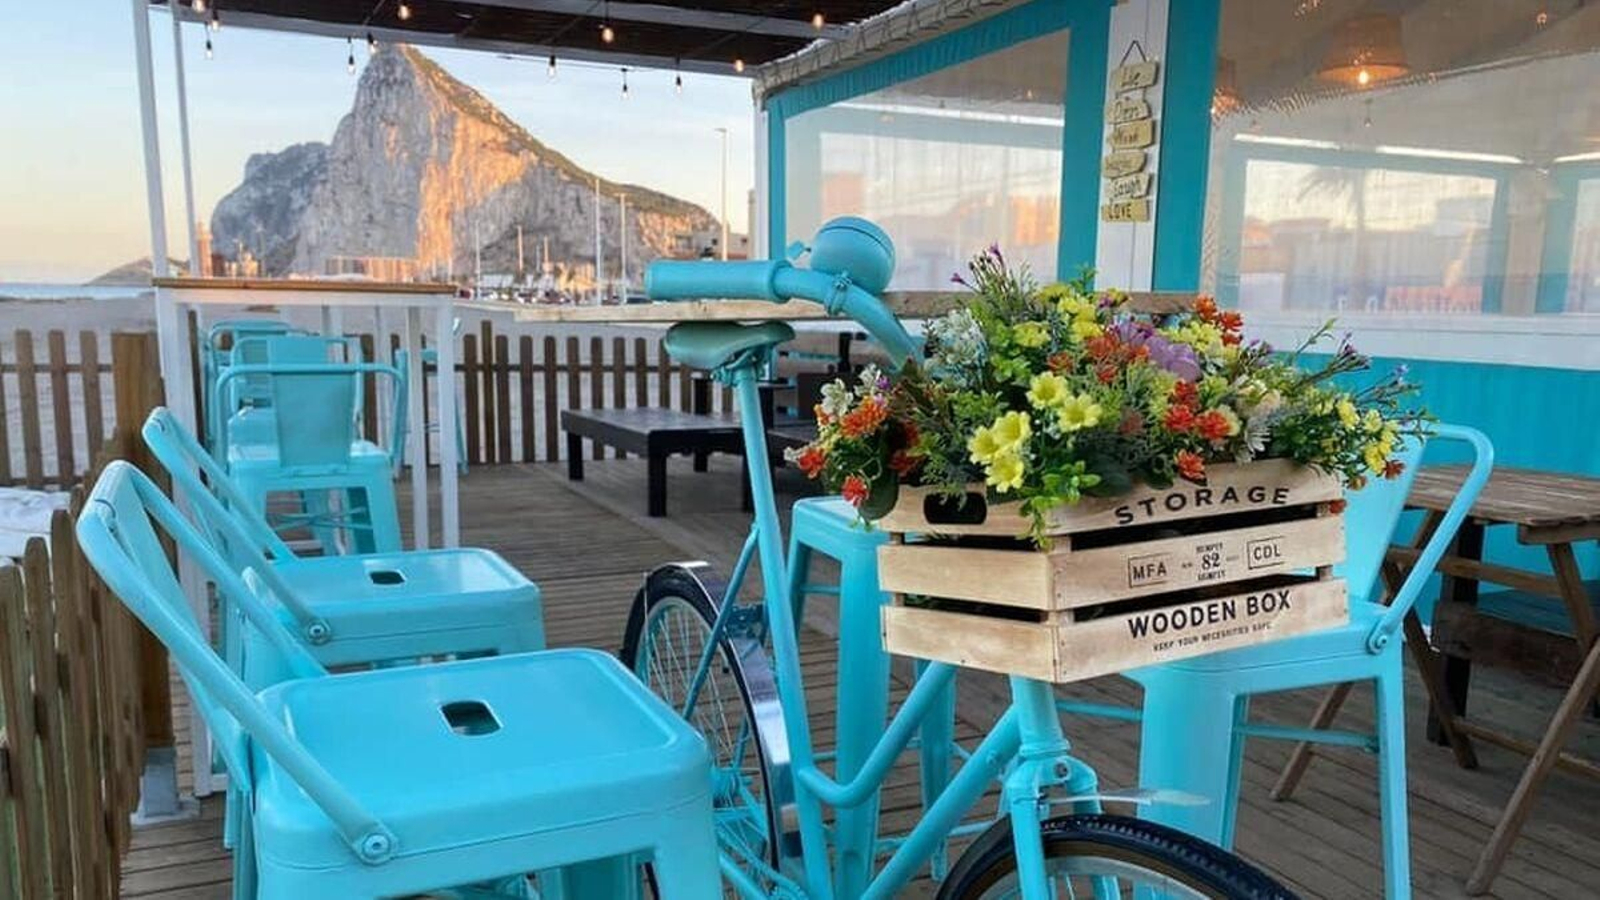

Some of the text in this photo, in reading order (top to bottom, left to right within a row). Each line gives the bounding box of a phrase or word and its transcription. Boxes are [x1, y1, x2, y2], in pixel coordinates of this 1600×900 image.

[1109, 202, 1132, 219] LOVE
[1114, 486, 1290, 525] STORAGE
[1201, 552, 1220, 570] 82
[1253, 543, 1281, 561] CDL
[1132, 561, 1167, 580] MFA
[1128, 589, 1291, 639] WOODEN BOX
